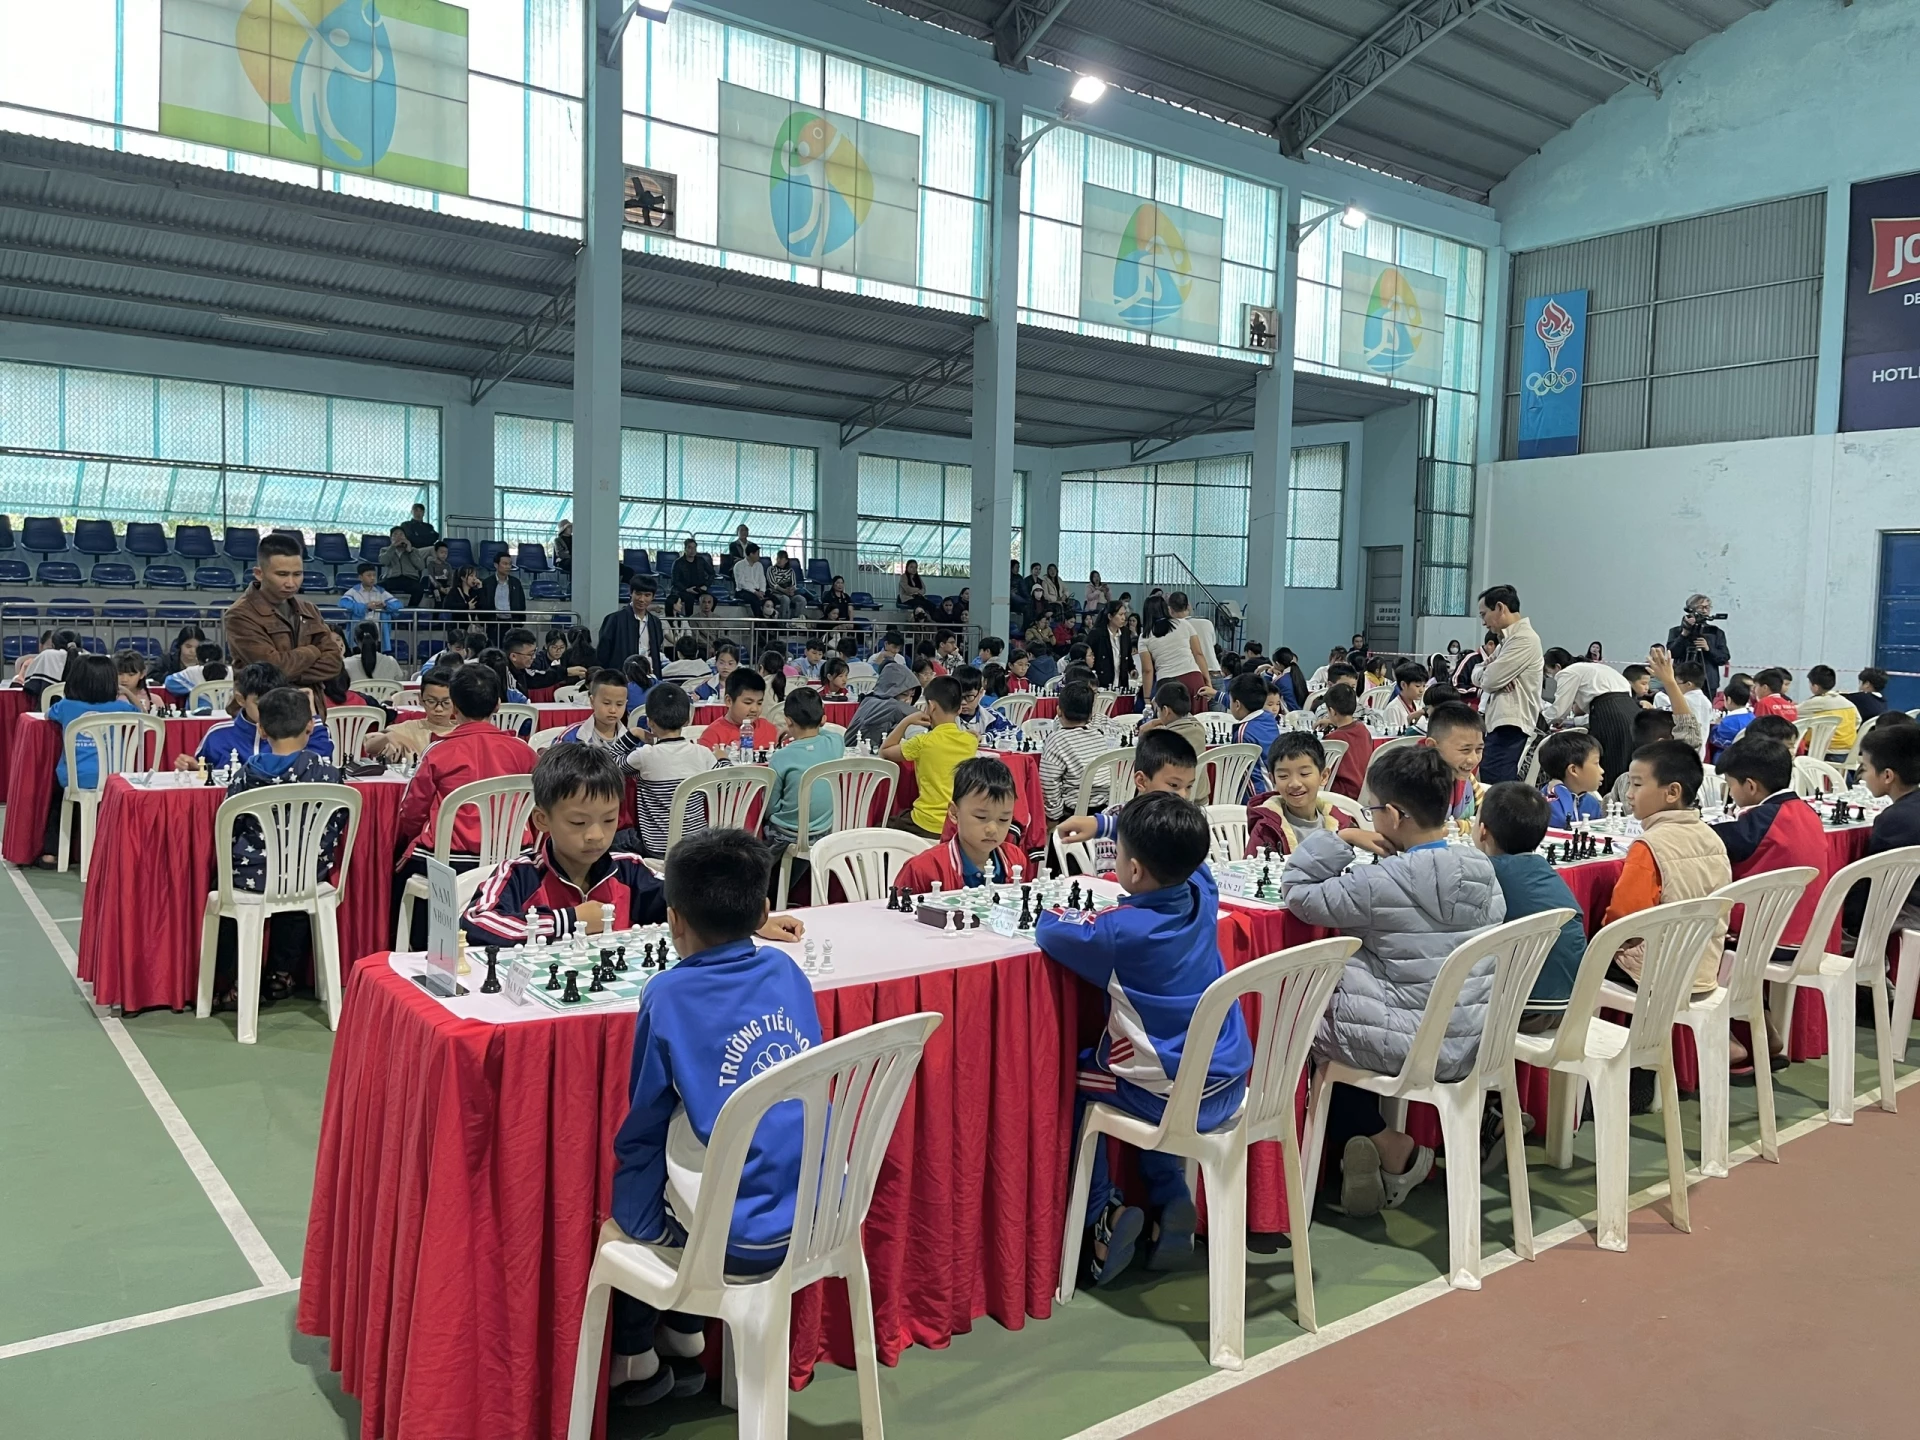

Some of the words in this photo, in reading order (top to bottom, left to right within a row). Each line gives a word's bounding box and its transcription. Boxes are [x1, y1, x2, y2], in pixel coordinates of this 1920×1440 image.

[431, 882, 451, 908] NAM
[719, 1019, 763, 1087] TRƯỜNG
[761, 1006, 793, 1033] TIỂU
